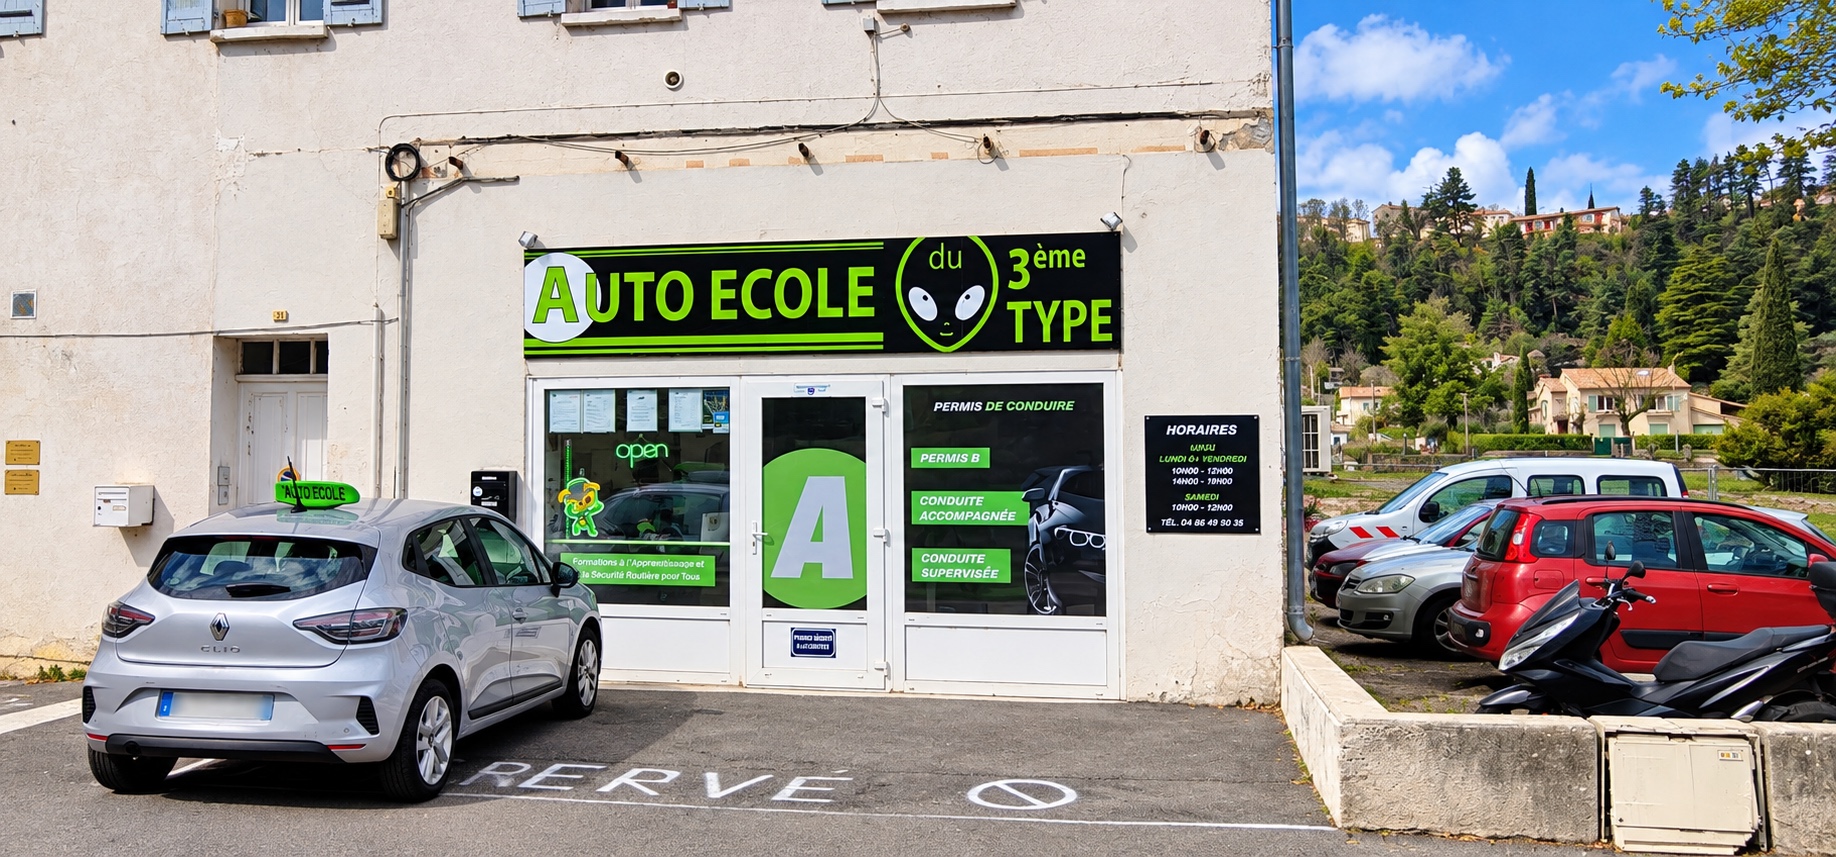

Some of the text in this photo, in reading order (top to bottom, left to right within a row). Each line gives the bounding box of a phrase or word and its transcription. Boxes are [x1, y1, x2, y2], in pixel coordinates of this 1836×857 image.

[929, 242, 962, 270] du
[531, 266, 876, 324] AUTO ECOLE
[1006, 299, 1113, 344] TYPE
[933, 400, 1075, 412] PERMIS DE CONDUIRE
[1166, 424, 1238, 436] HORAIRES
[615, 443, 669, 469] open
[920, 453, 981, 463] PERMIS B
[312, 486, 346, 501] ECOLE
[1184, 493, 1220, 501] SAMEDI
[919, 496, 984, 506] CONDUITE
[1171, 503, 1199, 511] 10H00
[919, 508, 1016, 521] ACCOMPAGNÉE
[770, 475, 854, 579] A
[1180, 518, 1192, 527] 04
[572, 557, 618, 567] Formations
[695, 560, 705, 568] et
[921, 553, 986, 564] CONDUITE
[681, 572, 701, 581] Tous
[920, 566, 999, 579] SUPERVISÉE
[200, 645, 241, 653] CLIO
